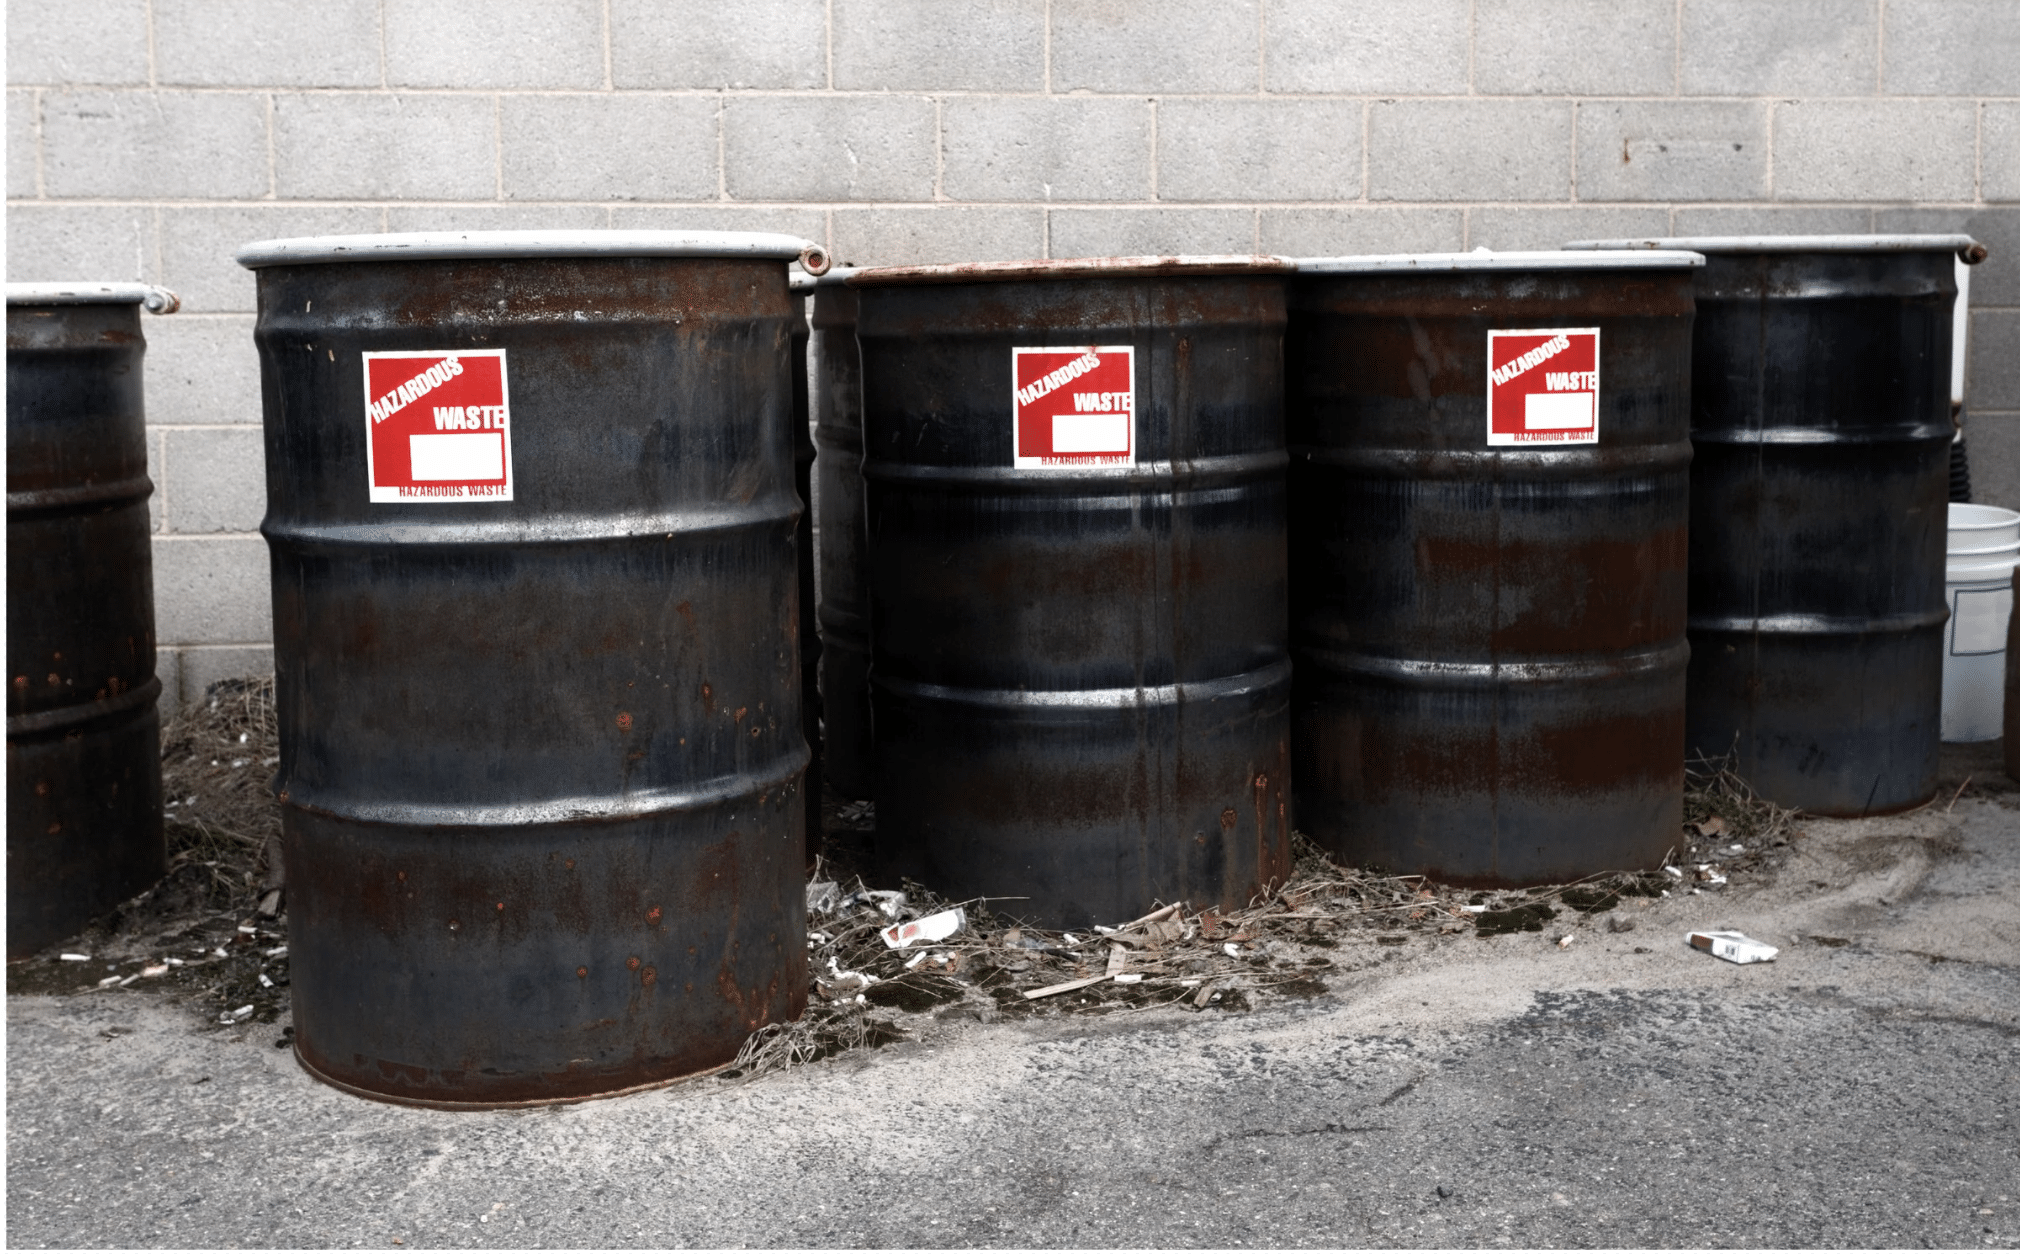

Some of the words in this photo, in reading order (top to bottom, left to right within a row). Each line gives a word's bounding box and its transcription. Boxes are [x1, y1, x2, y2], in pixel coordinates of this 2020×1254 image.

[1491, 334, 1570, 386] HAZARDOUS
[370, 356, 464, 424] HAZARDOUS
[1017, 352, 1101, 406] HAZARDOUS
[1545, 371, 1597, 391] WASTE
[1073, 392, 1131, 412] WASTE
[433, 405, 507, 430] WASTE
[399, 485, 464, 497] HAZARDOUS
[468, 485, 507, 496] WASTE
